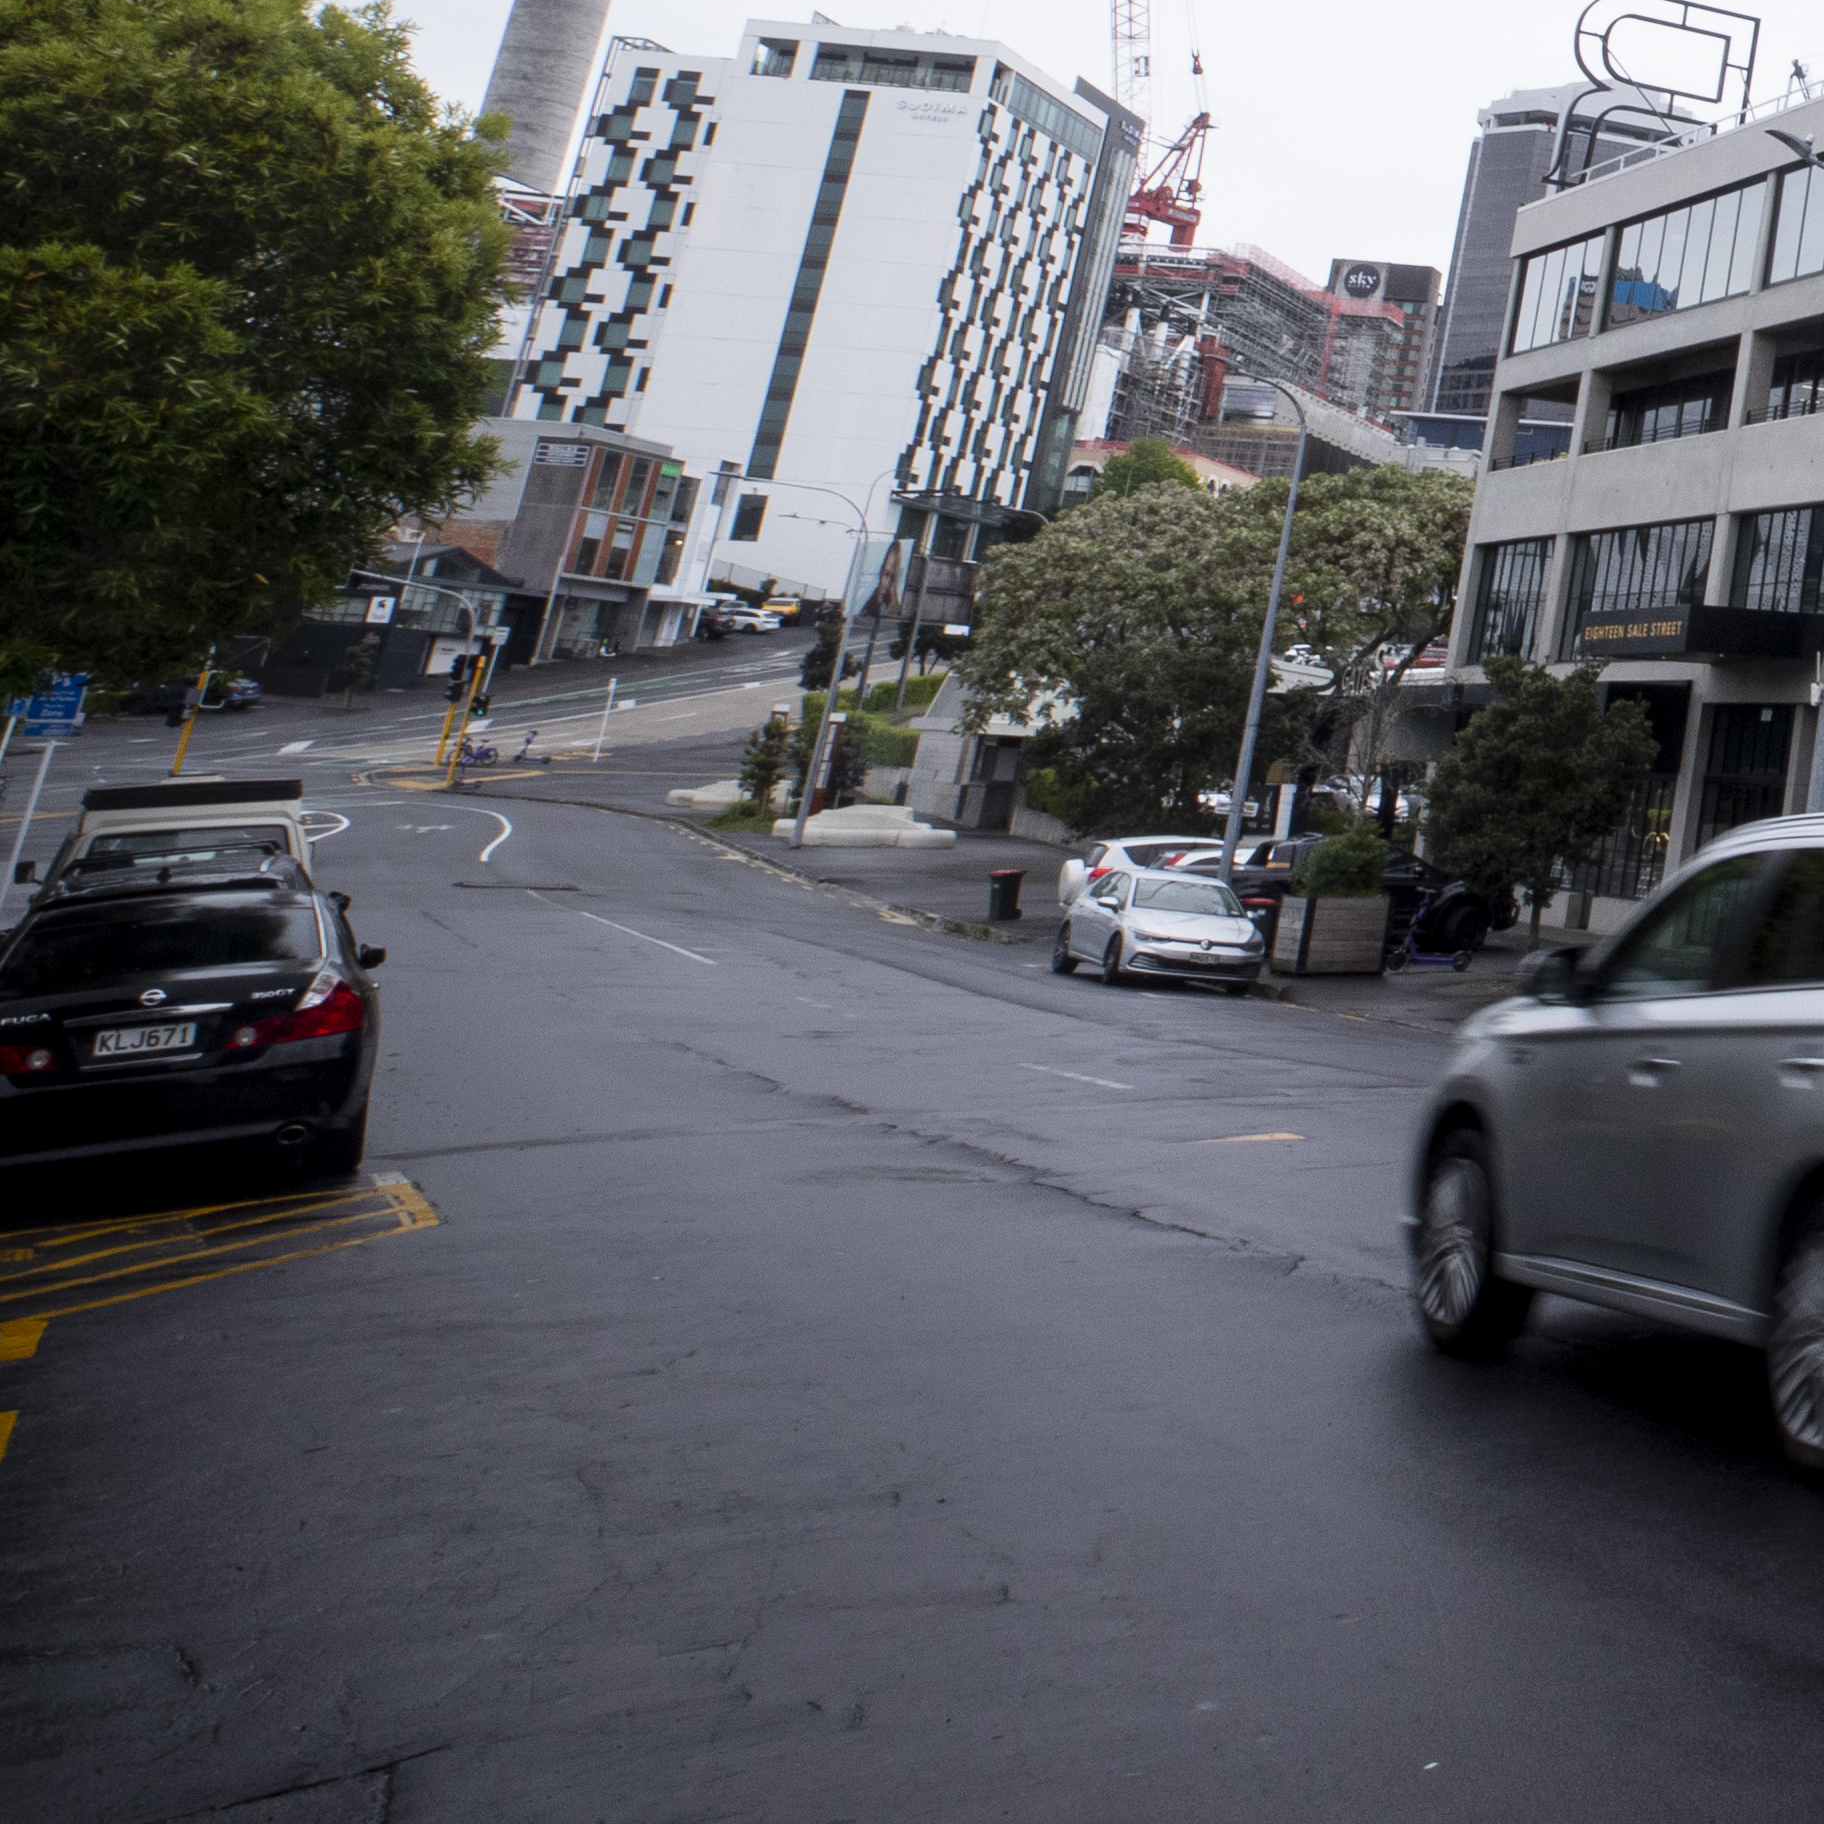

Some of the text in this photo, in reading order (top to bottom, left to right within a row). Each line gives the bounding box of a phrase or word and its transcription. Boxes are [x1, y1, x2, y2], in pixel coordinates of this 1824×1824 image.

[1584, 621, 1682, 641] EIGHTEEN SALE STREET
[99, 1028, 188, 1052] KLJ671
